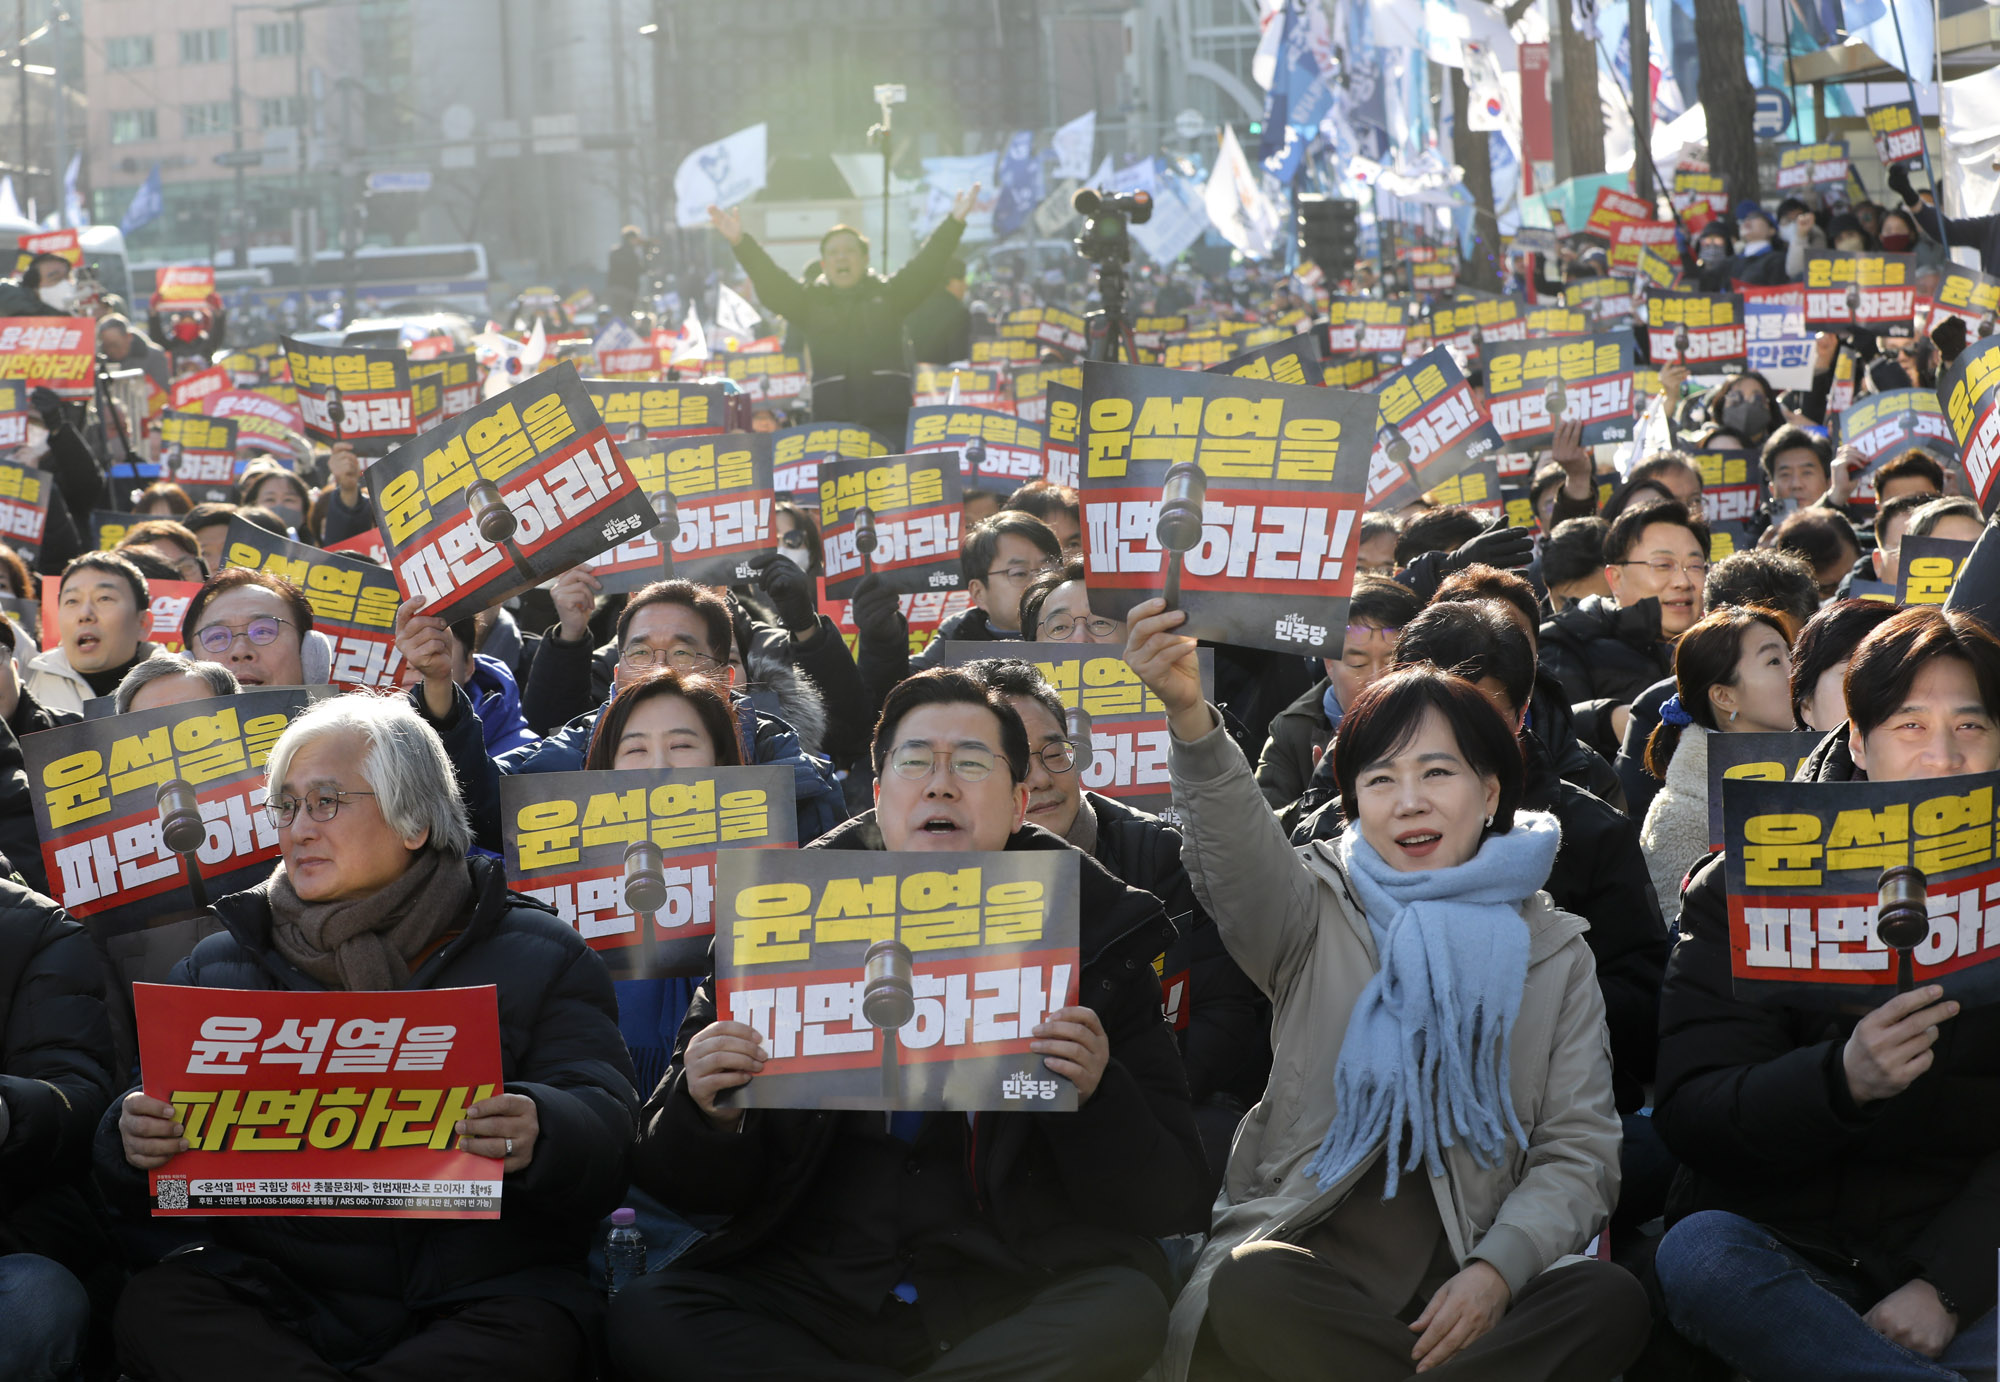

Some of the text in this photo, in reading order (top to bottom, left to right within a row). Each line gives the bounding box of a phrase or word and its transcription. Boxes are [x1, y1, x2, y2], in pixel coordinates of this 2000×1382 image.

[1808, 257, 1905, 288] 윤석열을
[1648, 297, 1733, 327] 윤석열을
[0, 354, 92, 380] 면하라!
[288, 351, 396, 391] 윤석열을
[1489, 340, 1620, 394] 윤석열을
[912, 413, 1042, 450] 윤석열을
[1087, 396, 1341, 481] 윤석열을
[379, 392, 577, 548] 윤석열을
[625, 444, 753, 496] 석열을
[820, 463, 943, 526] 윤석열을
[601, 514, 643, 542] 민주당
[928, 574, 959, 587] 민주당
[1275, 619, 1328, 646] 민주당
[42, 707, 289, 829] 윤석열을
[517, 779, 768, 871] 윤석열을
[1743, 786, 2000, 886] 윤석열
[733, 867, 1045, 966] 윤석열을
[185, 1016, 457, 1075] 윤석열을
[1002, 1079, 1058, 1100] 민주당
[197, 1181, 234, 1193] <윤석열
[236, 1182, 256, 1193] 파면
[259, 1182, 288, 1193] 국힘당
[291, 1182, 311, 1193] 해산
[372, 1182, 430, 1194] 헌법재판소로
[433, 1182, 465, 1195] 모이자!
[199, 1197, 213, 1205] 후원
[220, 1197, 247, 1205] 신한은행
[249, 1197, 305, 1205] 100-036-164860
[340, 1198, 354, 1206] ARS
